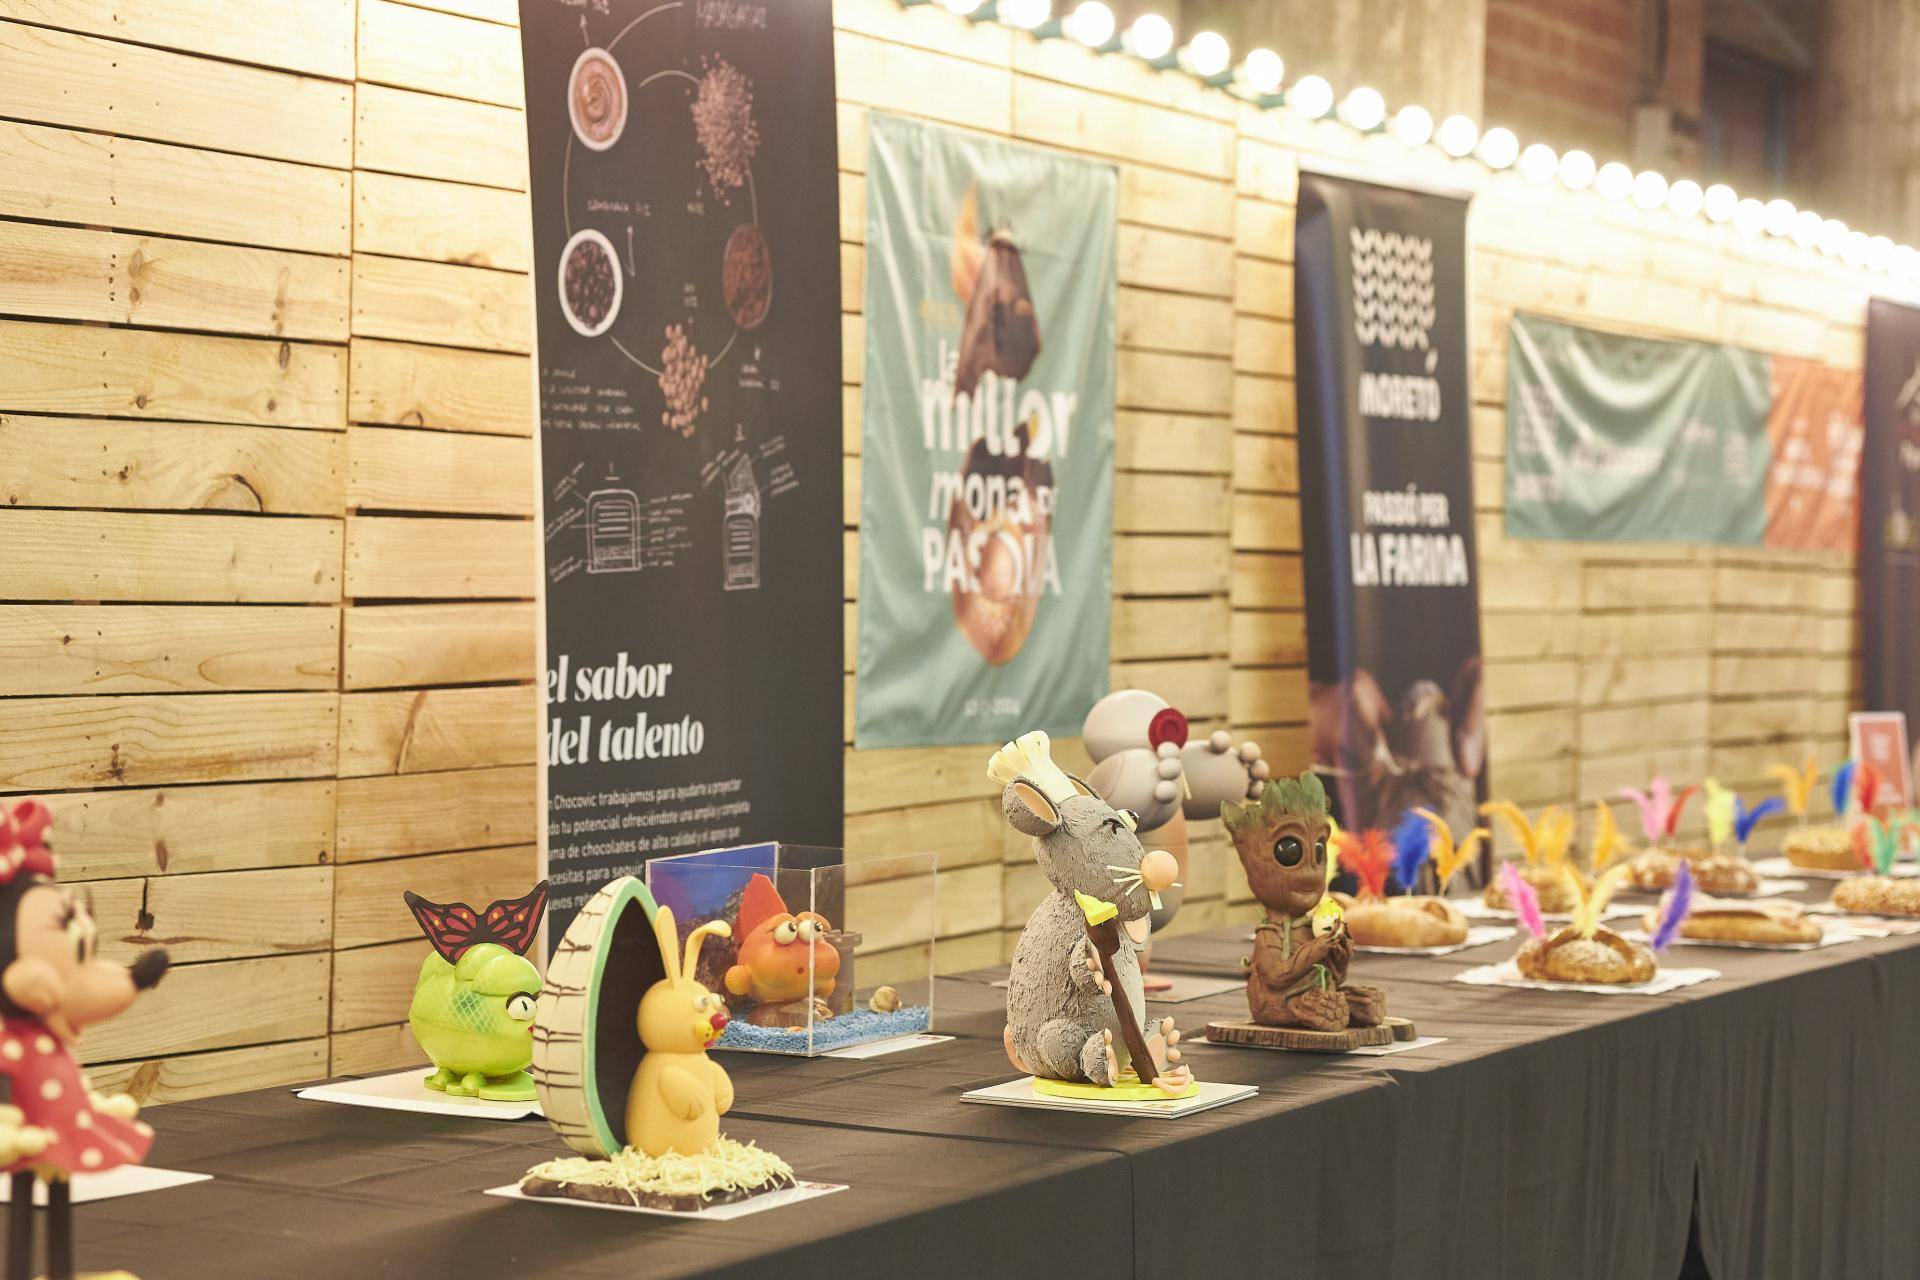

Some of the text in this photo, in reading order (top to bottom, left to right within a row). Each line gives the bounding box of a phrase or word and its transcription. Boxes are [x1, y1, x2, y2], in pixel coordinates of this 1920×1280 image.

[921, 369, 1077, 459] millor
[928, 470, 1033, 524] mona
[1350, 531, 1379, 586] LA
[546, 651, 673, 705] el sabor
[547, 711, 705, 766] del talento
[553, 794, 598, 811] Chocovic
[598, 788, 655, 808] trabajamos
[655, 788, 676, 804] para
[549, 821, 560, 836] do
[561, 821, 572, 834] tu
[573, 813, 621, 837] potencial
[621, 809, 679, 829] ofreciéndote
[549, 847, 566, 861] ama
[566, 843, 580, 859] de
[581, 839, 637, 857] chocolates
[637, 836, 651, 852] de
[651, 834, 669, 850] alta
[549, 868, 585, 886] ecesitas
[585, 867, 611, 885] para
[549, 896, 573, 912] uevos
